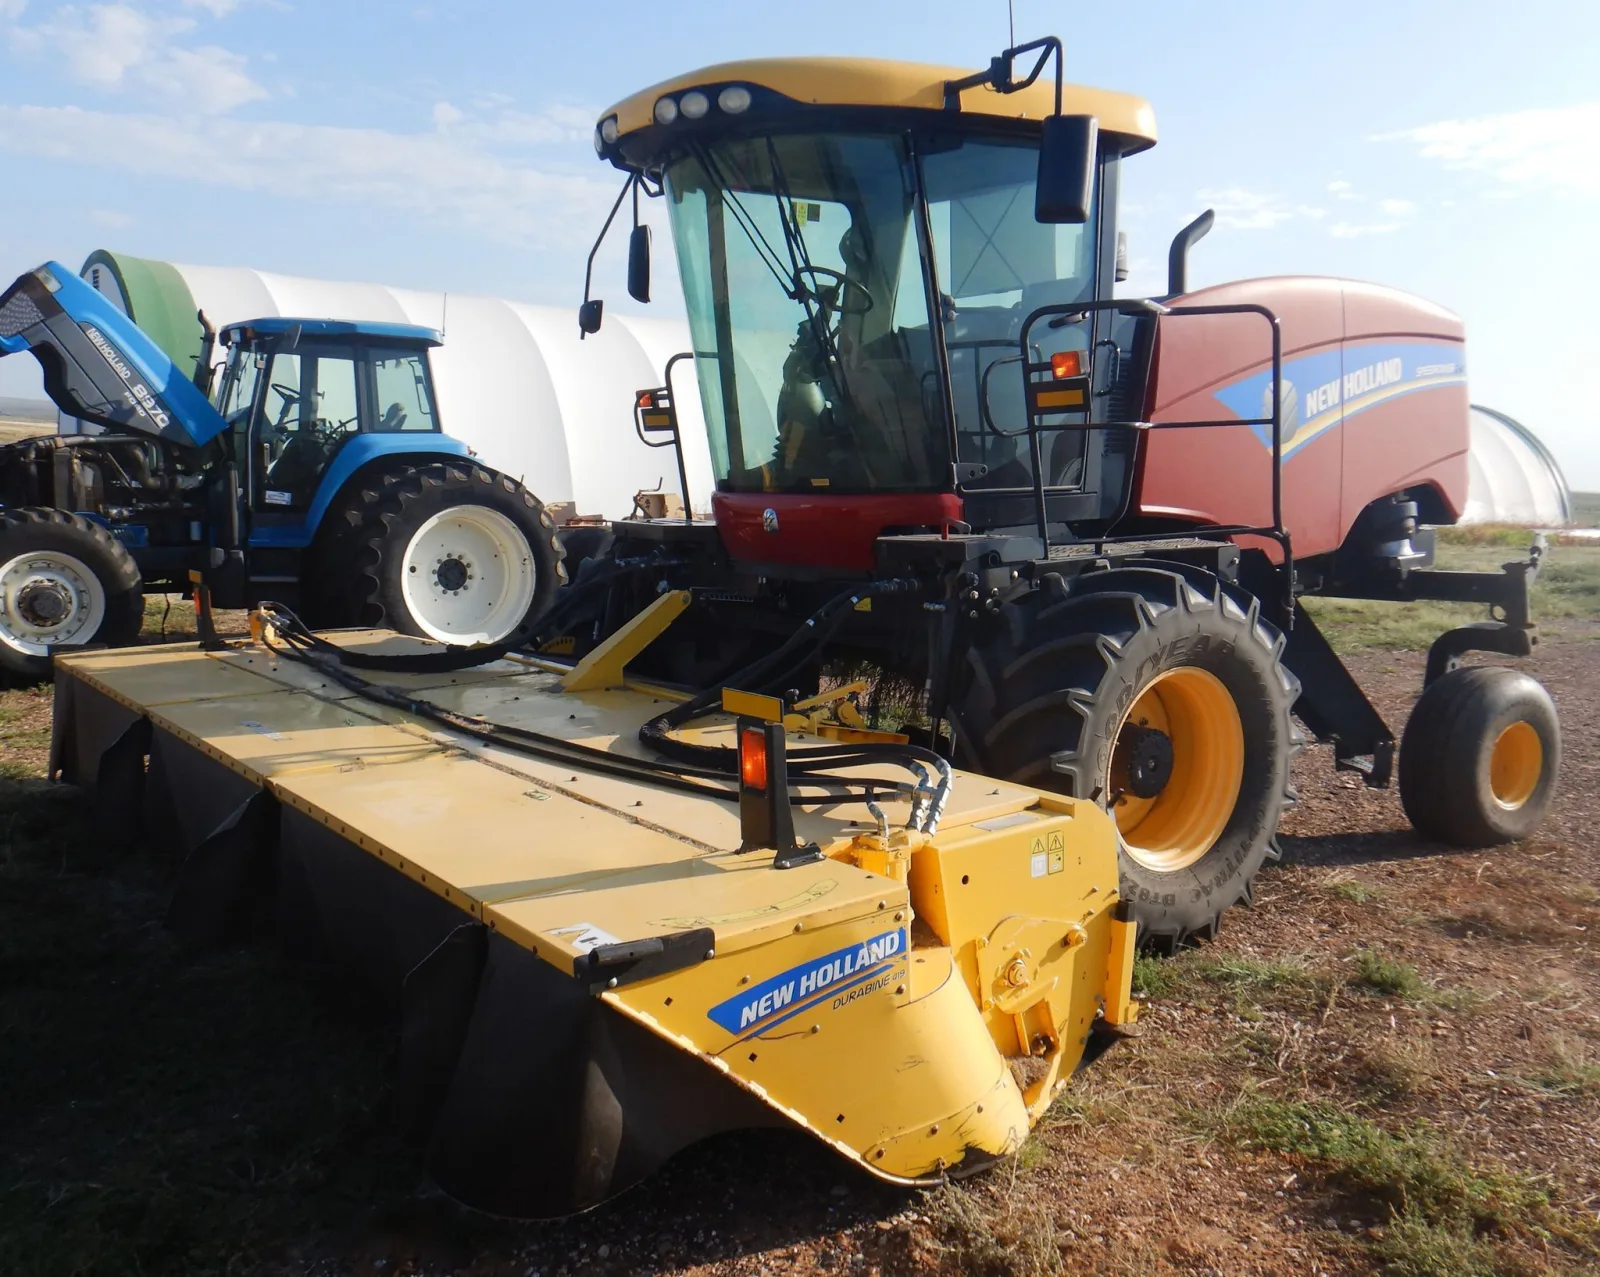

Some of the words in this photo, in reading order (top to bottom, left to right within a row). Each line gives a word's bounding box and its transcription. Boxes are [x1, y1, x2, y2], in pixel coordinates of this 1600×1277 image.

[86, 328, 105, 347] NEW
[100, 343, 131, 379] HOLLAND
[132, 384, 170, 428] 8970
[1305, 378, 1341, 418] NEW
[1343, 357, 1402, 400] HOLLAND
[740, 980, 795, 1029] NEW
[800, 931, 900, 997] HOLLAND
[833, 974, 891, 1010] DURABINE
